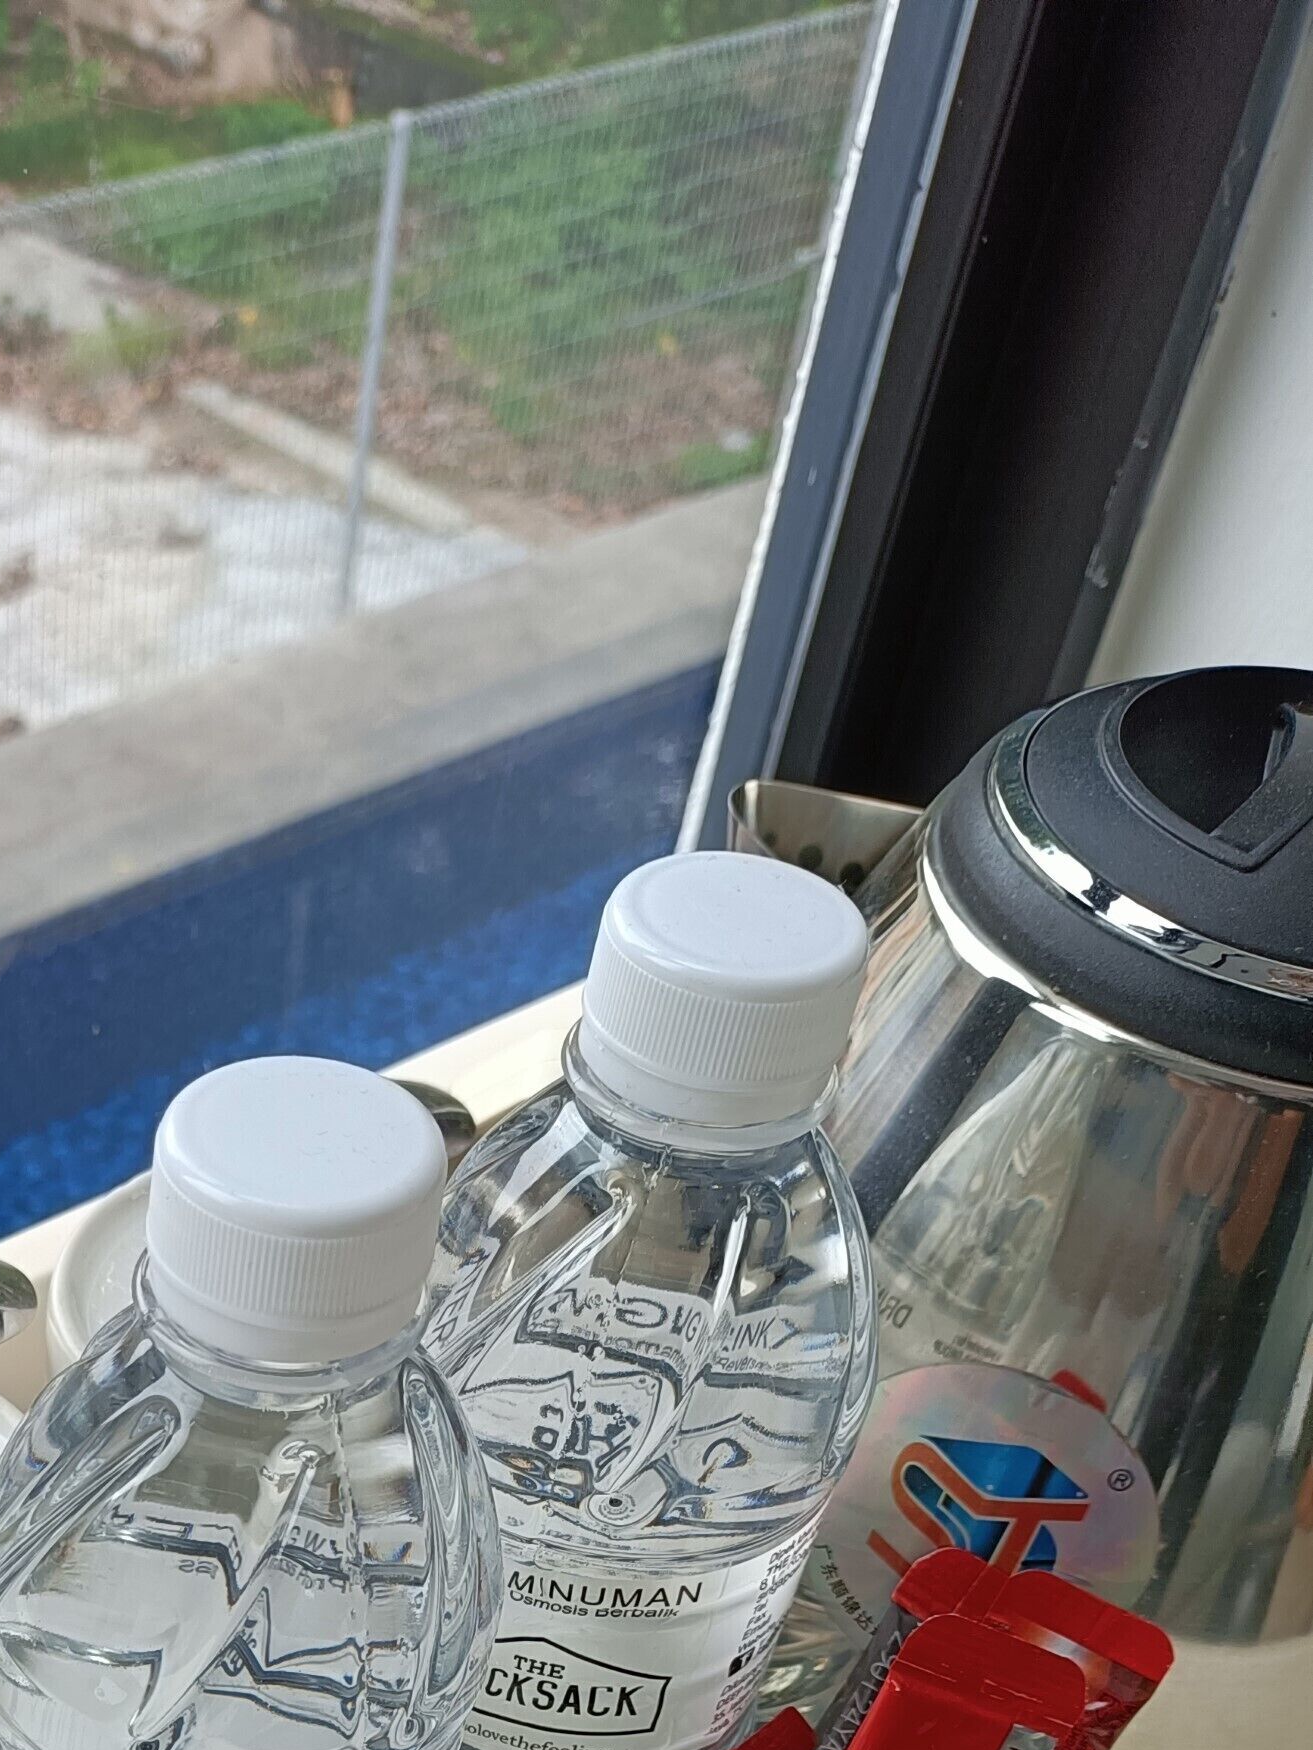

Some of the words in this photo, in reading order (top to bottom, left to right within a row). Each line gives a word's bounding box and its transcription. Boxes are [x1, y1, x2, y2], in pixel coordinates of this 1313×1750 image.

[507, 1570, 703, 1608] MINUMAN
[509, 1590, 589, 1617] Osmosis
[513, 1654, 566, 1680] THE
[485, 1667, 645, 1717] CKSACK
